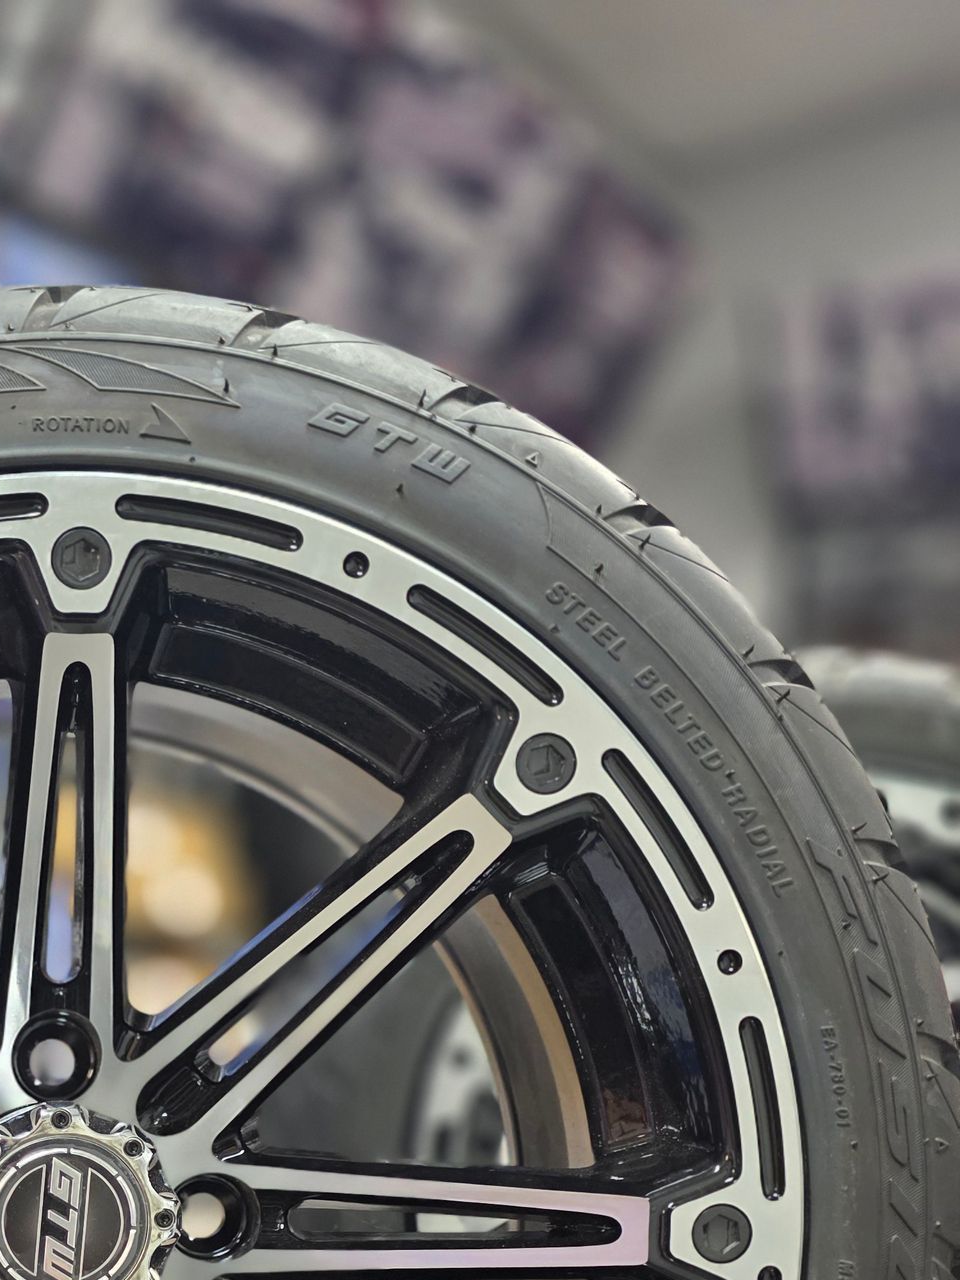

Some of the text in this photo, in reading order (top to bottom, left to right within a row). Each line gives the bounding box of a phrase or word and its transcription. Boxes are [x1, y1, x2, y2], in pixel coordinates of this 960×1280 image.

[31, 417, 131, 435] ROTATION
[307, 403, 472, 484] GTW
[544, 580, 797, 900] STEEL BELTED RADIAL
[817, 1022, 852, 1131] EA-780-01
